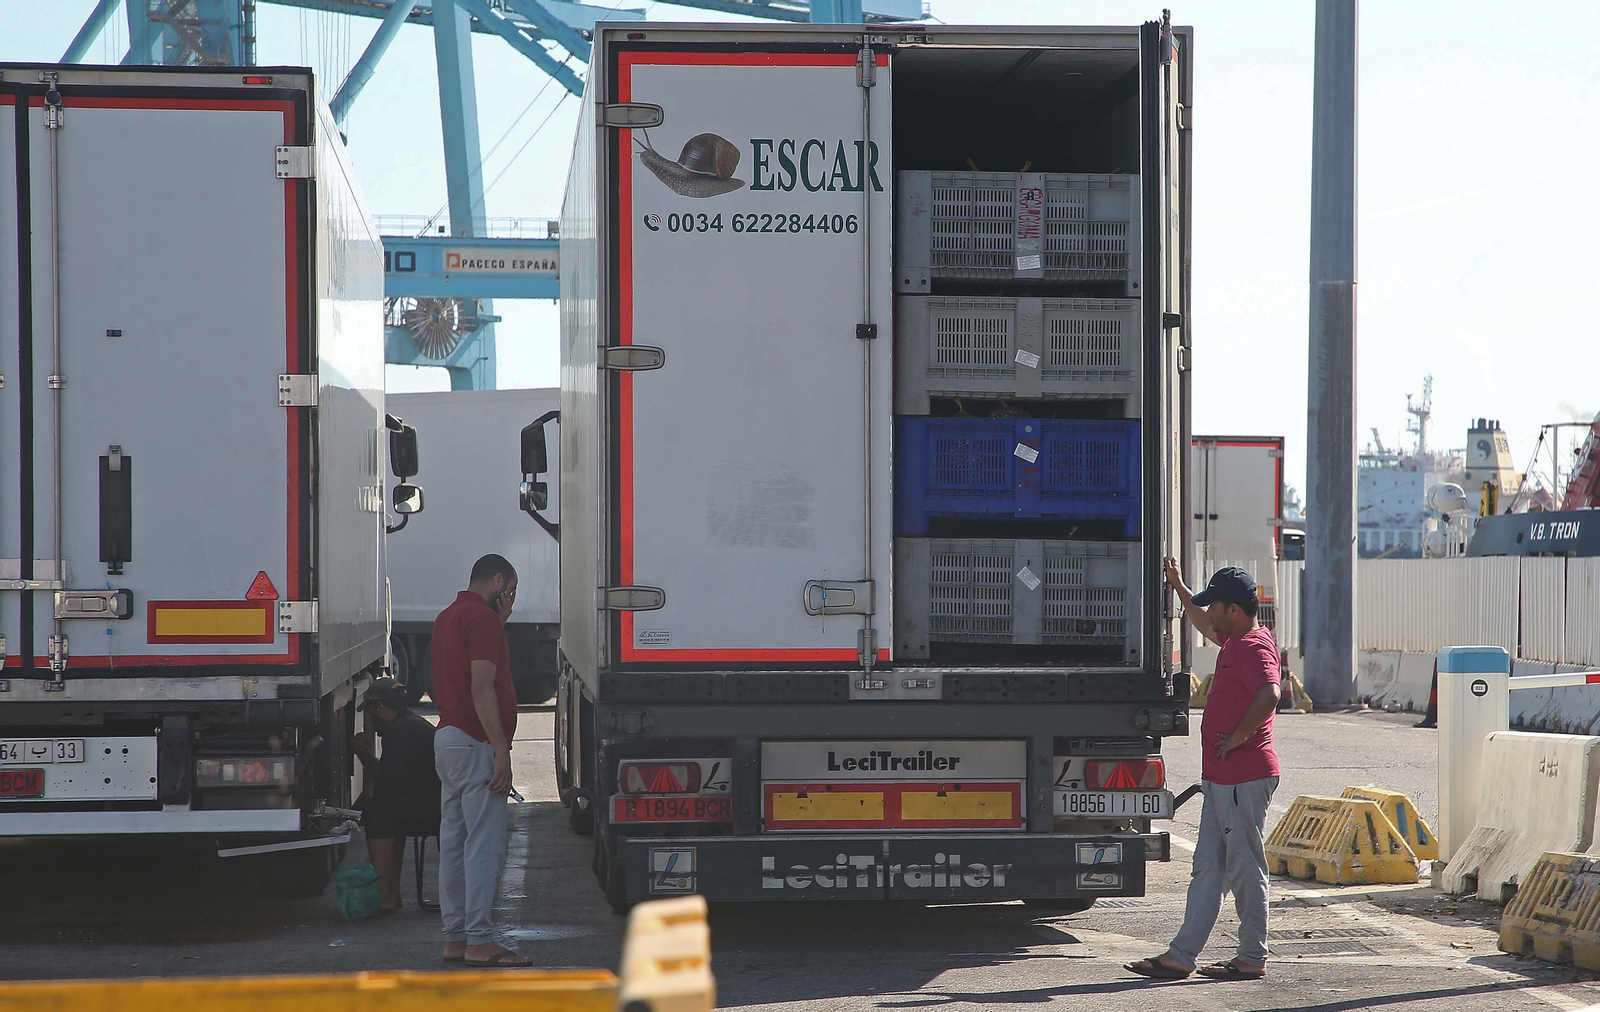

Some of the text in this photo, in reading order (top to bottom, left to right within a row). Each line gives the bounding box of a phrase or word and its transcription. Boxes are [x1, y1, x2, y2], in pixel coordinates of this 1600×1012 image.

[749, 138, 884, 192] ESCAR
[667, 213, 858, 234] 0034 622284406
[461, 259, 505, 269] PACECO
[512, 258, 557, 270] ESPAÑA
[1530, 521, 1580, 541] V.B. TRON
[0, 743, 17, 760] 64
[57, 742, 76, 759] 33
[827, 750, 960, 771] LeciTrailer
[1, 773, 37, 792] BCM
[625, 799, 731, 818] R 1894 BCR
[1062, 793, 1106, 813] 18856
[1142, 794, 1160, 813] 60
